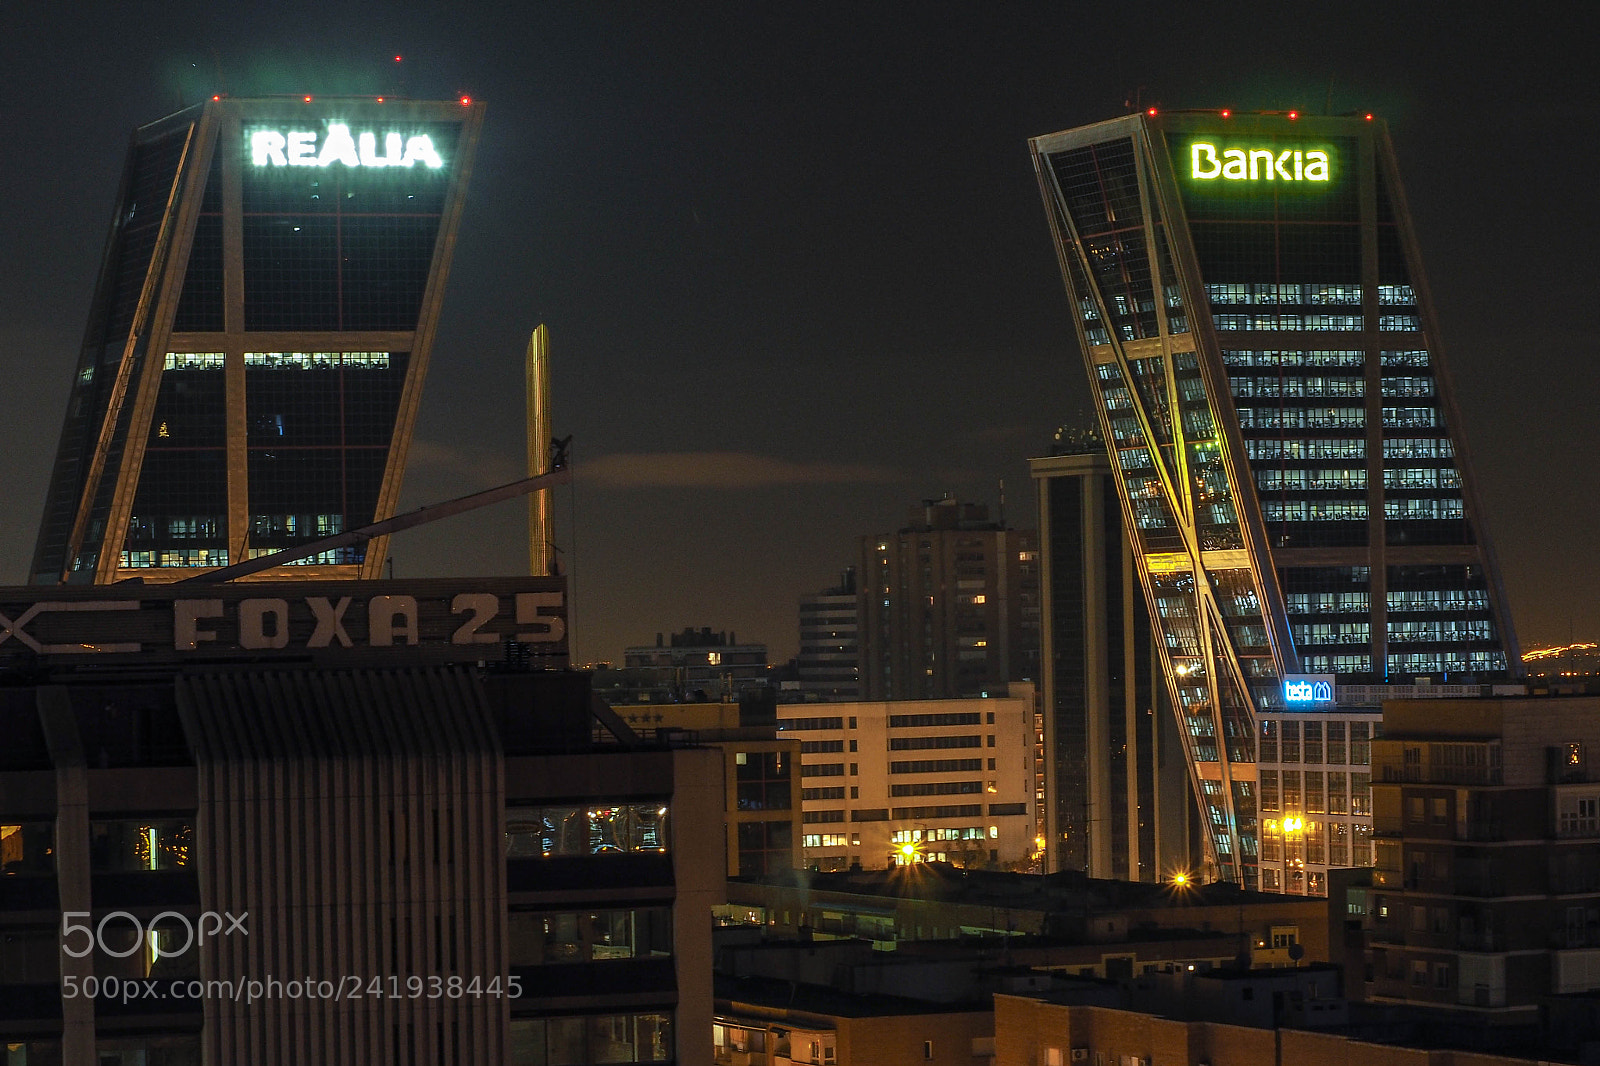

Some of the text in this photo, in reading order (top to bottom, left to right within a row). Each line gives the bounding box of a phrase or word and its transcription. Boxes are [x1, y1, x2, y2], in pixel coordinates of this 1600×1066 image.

[252, 124, 443, 168] REALIA
[1191, 142, 1330, 181] Bankia
[174, 592, 565, 650] FOXA 25
[1285, 681, 1313, 701] testa
